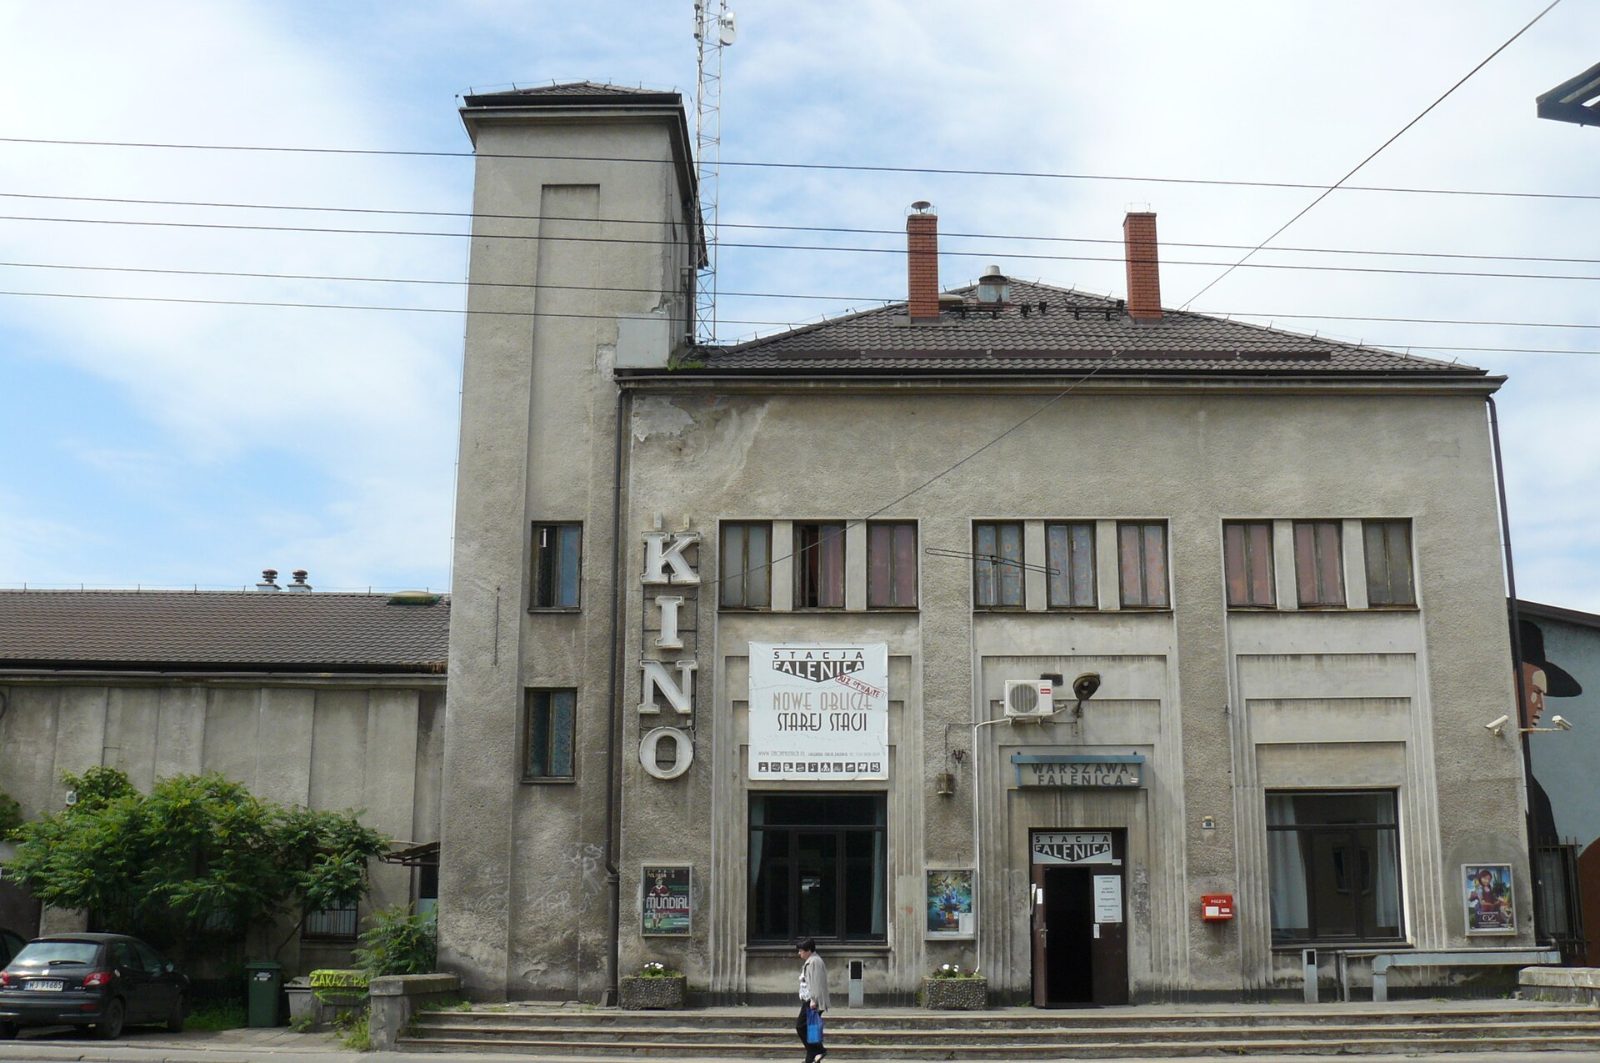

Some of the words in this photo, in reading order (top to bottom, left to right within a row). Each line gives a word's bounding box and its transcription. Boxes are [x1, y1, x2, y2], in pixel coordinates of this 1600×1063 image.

[637, 531, 702, 780] KINO
[773, 651, 863, 660] STACJA
[773, 661, 863, 681] FALENICA
[773, 691, 812, 711] NOWE
[820, 691, 873, 711] OBLICZE
[777, 712, 822, 732] STAREJ
[829, 712, 867, 732] STACJI
[1037, 774, 1124, 786] FALENICA
[1035, 835, 1109, 844] STACJA
[1034, 844, 1110, 861] FALENICA
[310, 973, 348, 987] ZAKAZ
